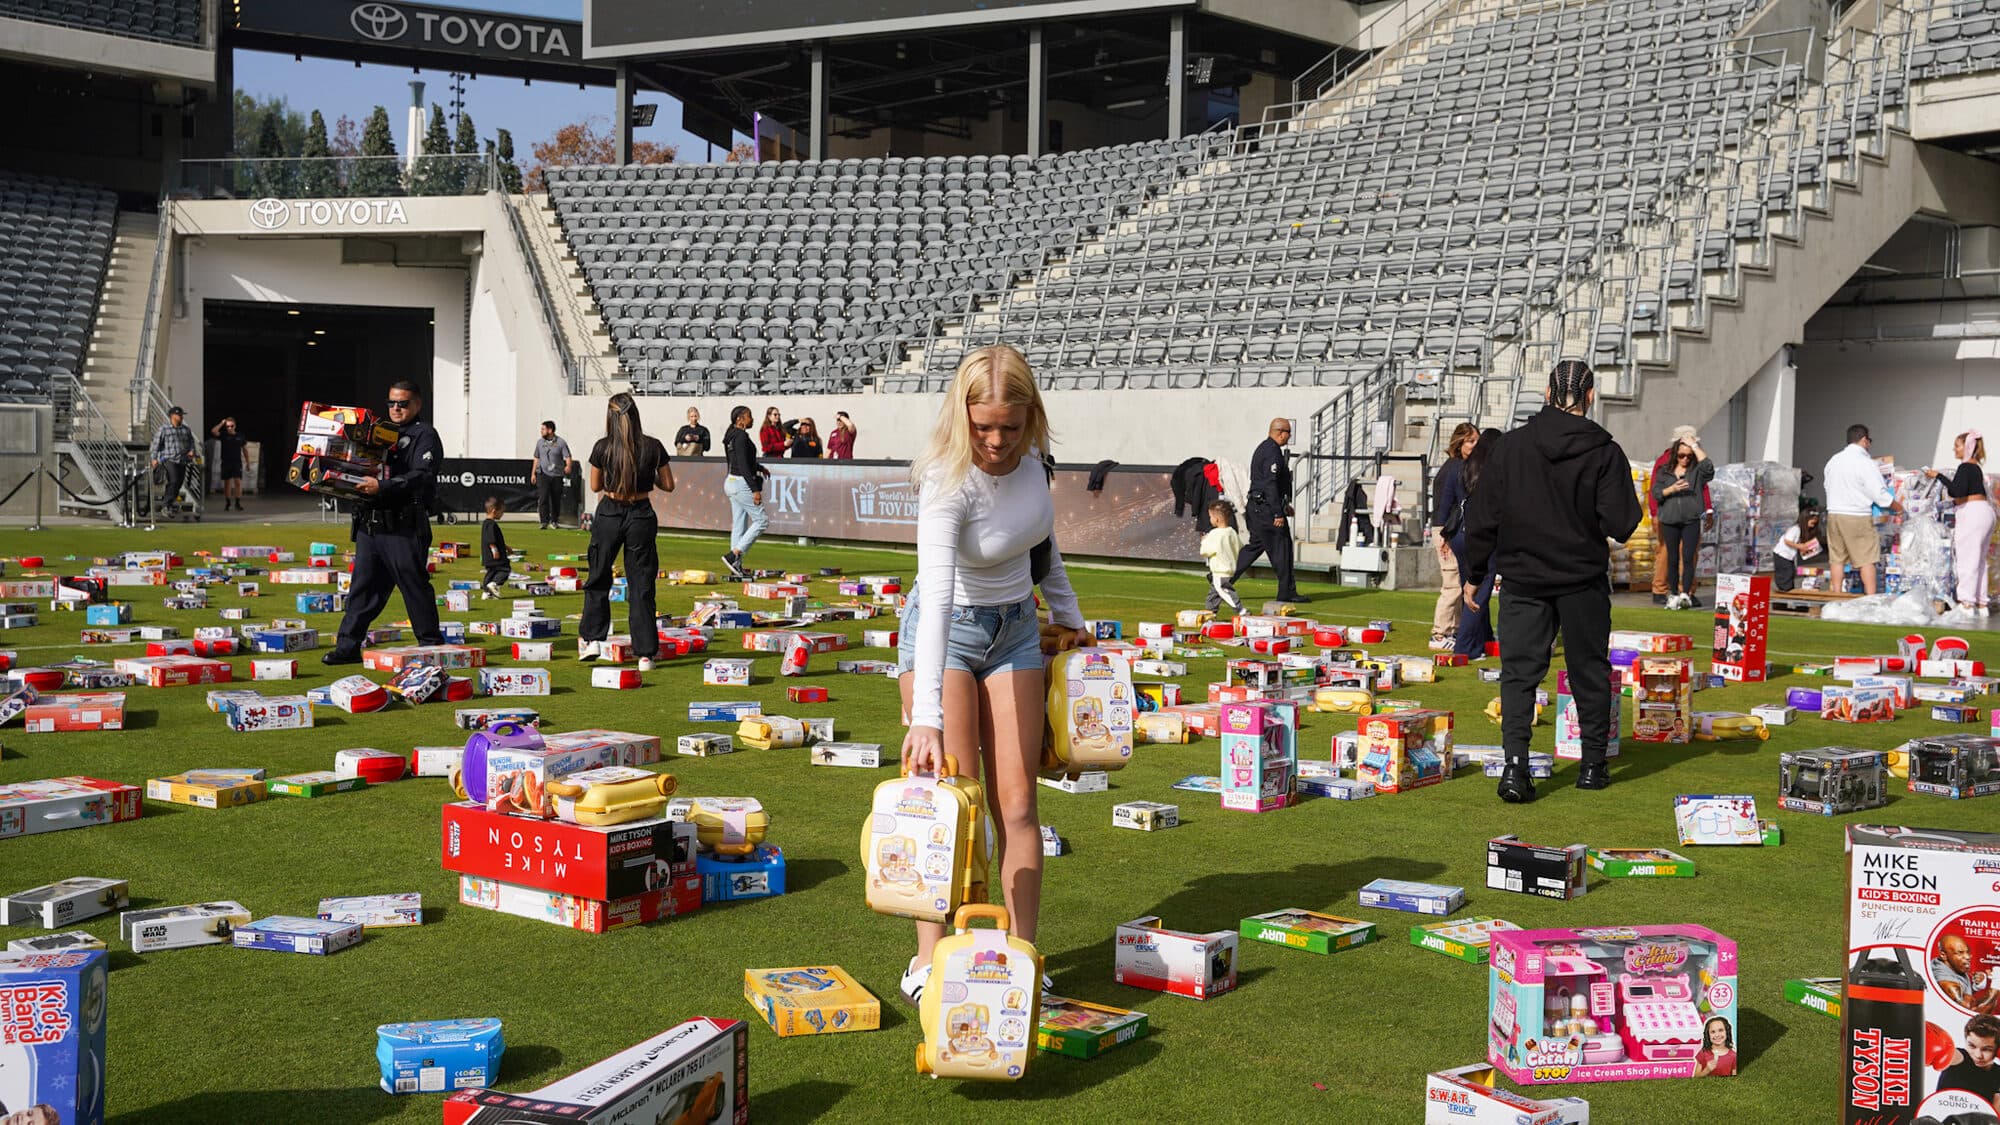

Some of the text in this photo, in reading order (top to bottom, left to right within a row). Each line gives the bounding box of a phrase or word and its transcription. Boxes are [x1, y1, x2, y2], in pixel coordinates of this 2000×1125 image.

[416, 12, 571, 57] TOYOTA
[294, 200, 408, 225] TOYOTA
[477, 475, 526, 485] STADIUM
[878, 502, 902, 517] TOY
[488, 826, 584, 861] TYSON
[609, 827, 653, 844] MIKE TYSON
[504, 852, 567, 879] MIKE
[1863, 852, 1919, 871] MIKE
[1628, 865, 1678, 876] SUBWAY
[1863, 870, 1937, 891] TYSON
[1861, 889, 1937, 904] KID'S BOXING
[1861, 902, 1937, 915] PUNCHING BAG
[1861, 911, 1878, 919] SET
[145, 925, 168, 933] STAR
[1959, 918, 1989, 929] TRAIN
[1965, 927, 1983, 936] THE
[1119, 934, 1153, 945] S.W.A.T.
[1258, 928, 1309, 947] SUBWAY
[1335, 929, 1370, 949] SUBWAY
[1420, 935, 1465, 957] SUBWAY
[1720, 952, 1733, 961] 3+
[1713, 987, 1728, 998] 33
[38, 985, 67, 1042] Kid's
[1801, 993, 1841, 1017] UBWAY
[0, 989, 17, 1044] Drum Set
[14, 987, 44, 1043] Band
[1098, 1022, 1139, 1052] SUBWAY
[474, 1043, 487, 1051] 3+
[1527, 1051, 1580, 1067] CREAM
[609, 1059, 650, 1086] MCLAREN
[654, 1054, 706, 1096] MCLAREN 765 LT
[1534, 1067, 1571, 1081] STOP
[1577, 1066, 1687, 1078] Ice Cream Shop Playset
[1851, 1027, 1882, 1112] TYSON
[1881, 1036, 1912, 1107] MIKE
[1429, 1087, 1469, 1105] S.W.A.T.
[1937, 1099, 1968, 1109] SOUND
[1948, 1095, 1969, 1103] REAL
[1449, 1102, 1476, 1115] TRUCK
